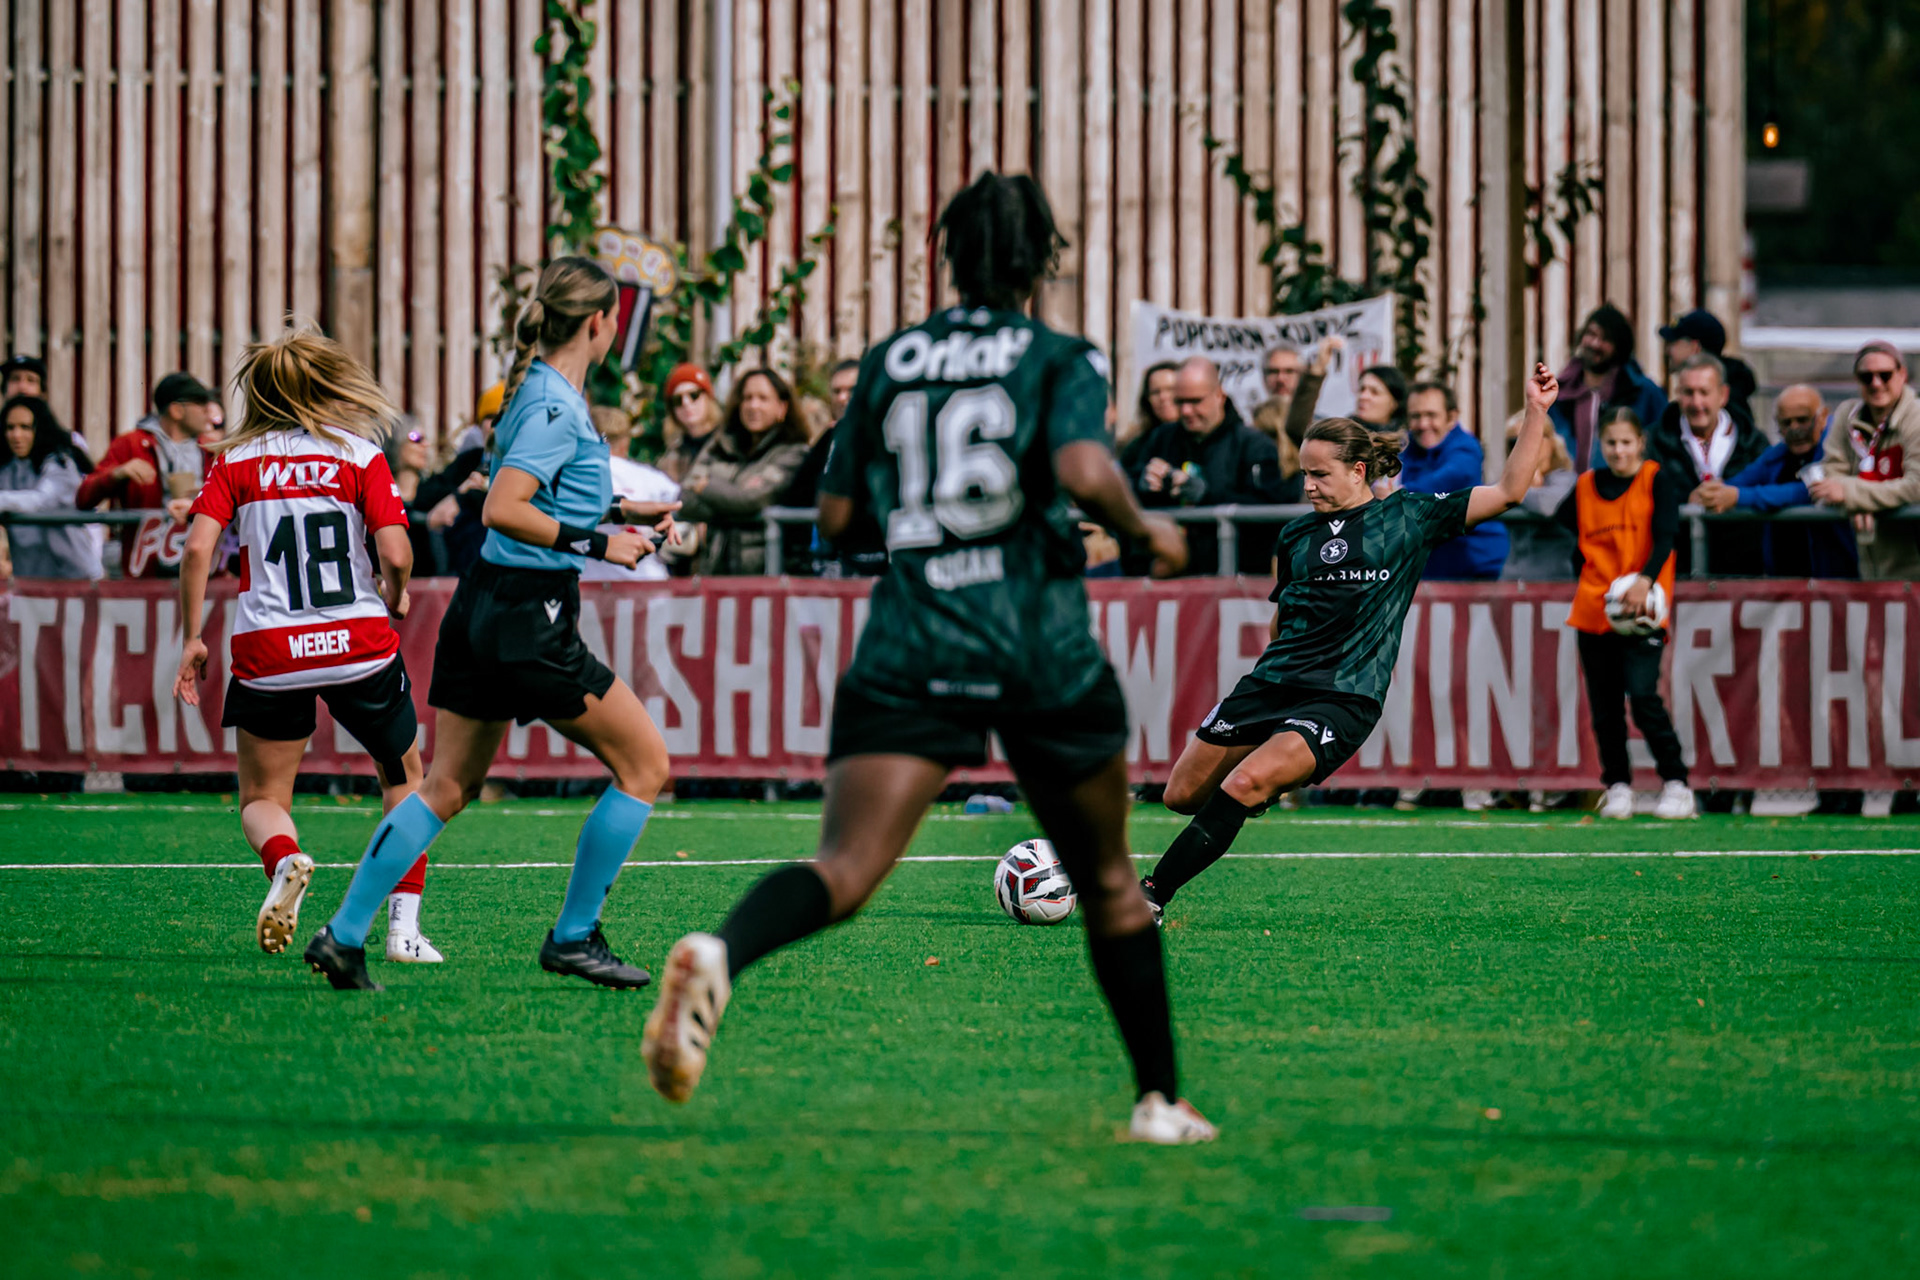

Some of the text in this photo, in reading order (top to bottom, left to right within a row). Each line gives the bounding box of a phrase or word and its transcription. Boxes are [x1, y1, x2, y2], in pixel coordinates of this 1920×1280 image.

[259, 461, 340, 488] WOZ
[883, 383, 1024, 549] 16
[265, 511, 356, 611] 18
[288, 629, 350, 659] WEBER
